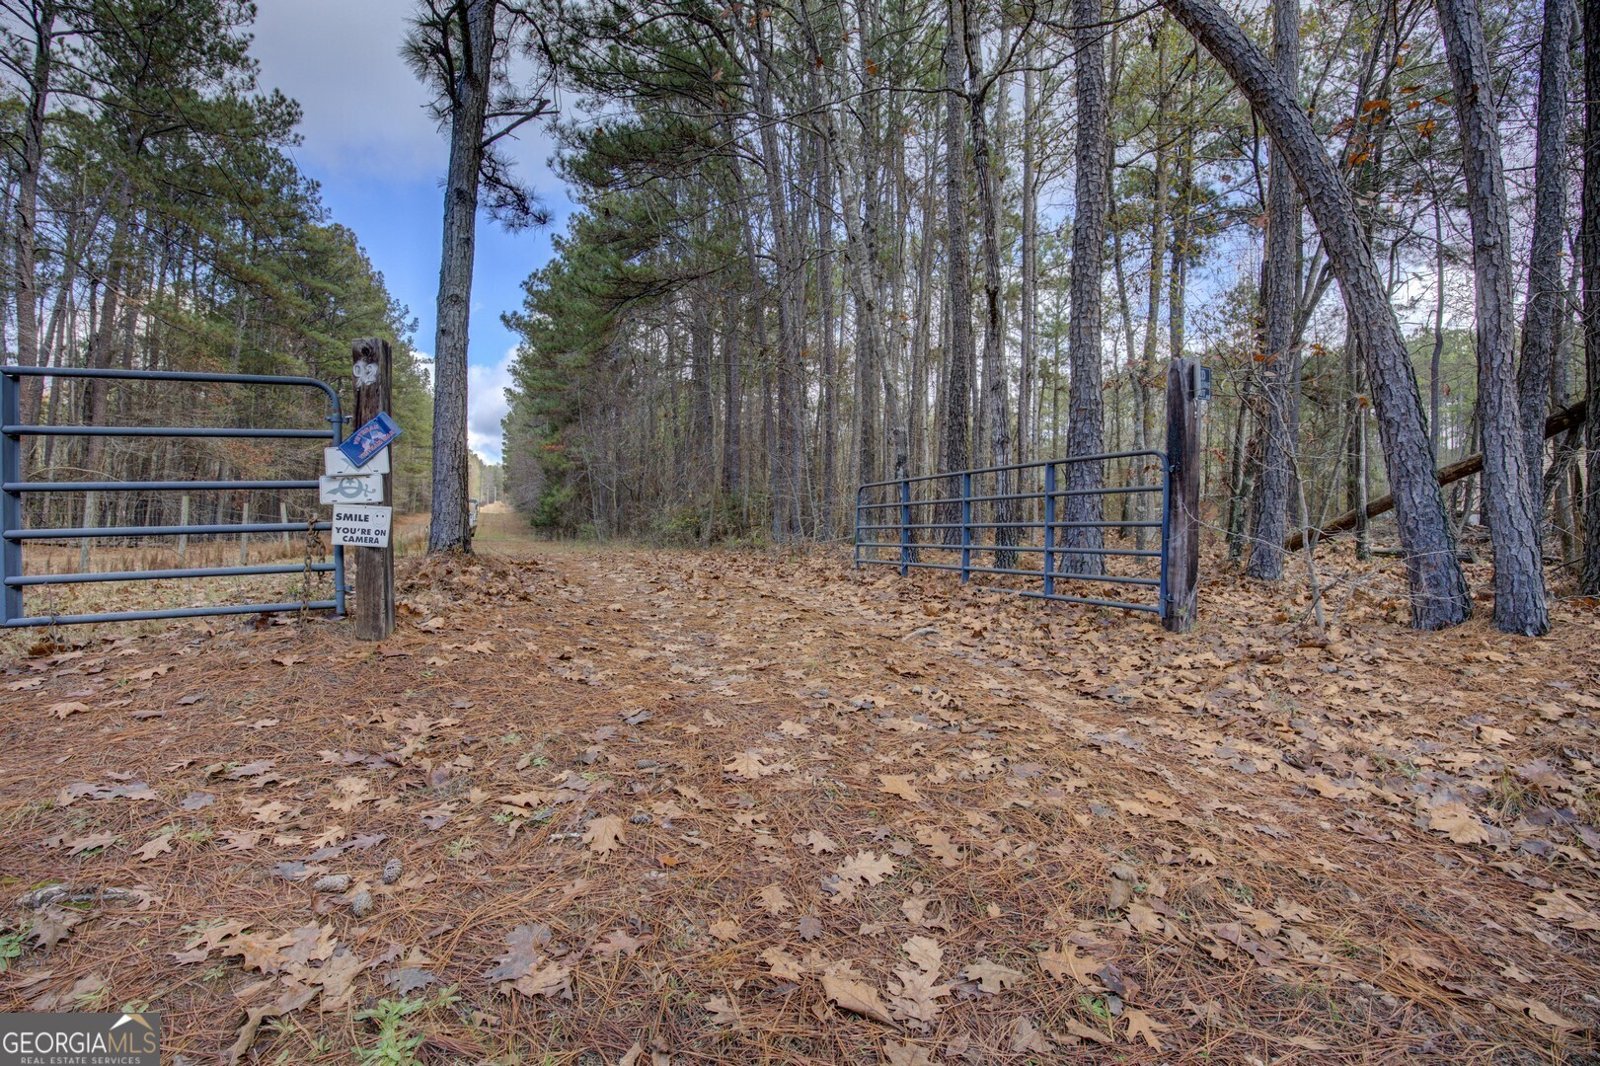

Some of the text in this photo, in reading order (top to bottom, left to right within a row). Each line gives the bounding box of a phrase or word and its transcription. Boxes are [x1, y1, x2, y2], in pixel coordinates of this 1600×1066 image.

[335, 512, 370, 522] SMILE
[335, 526, 387, 537] YOU'RE ON
[342, 535, 380, 544] CAMERA
